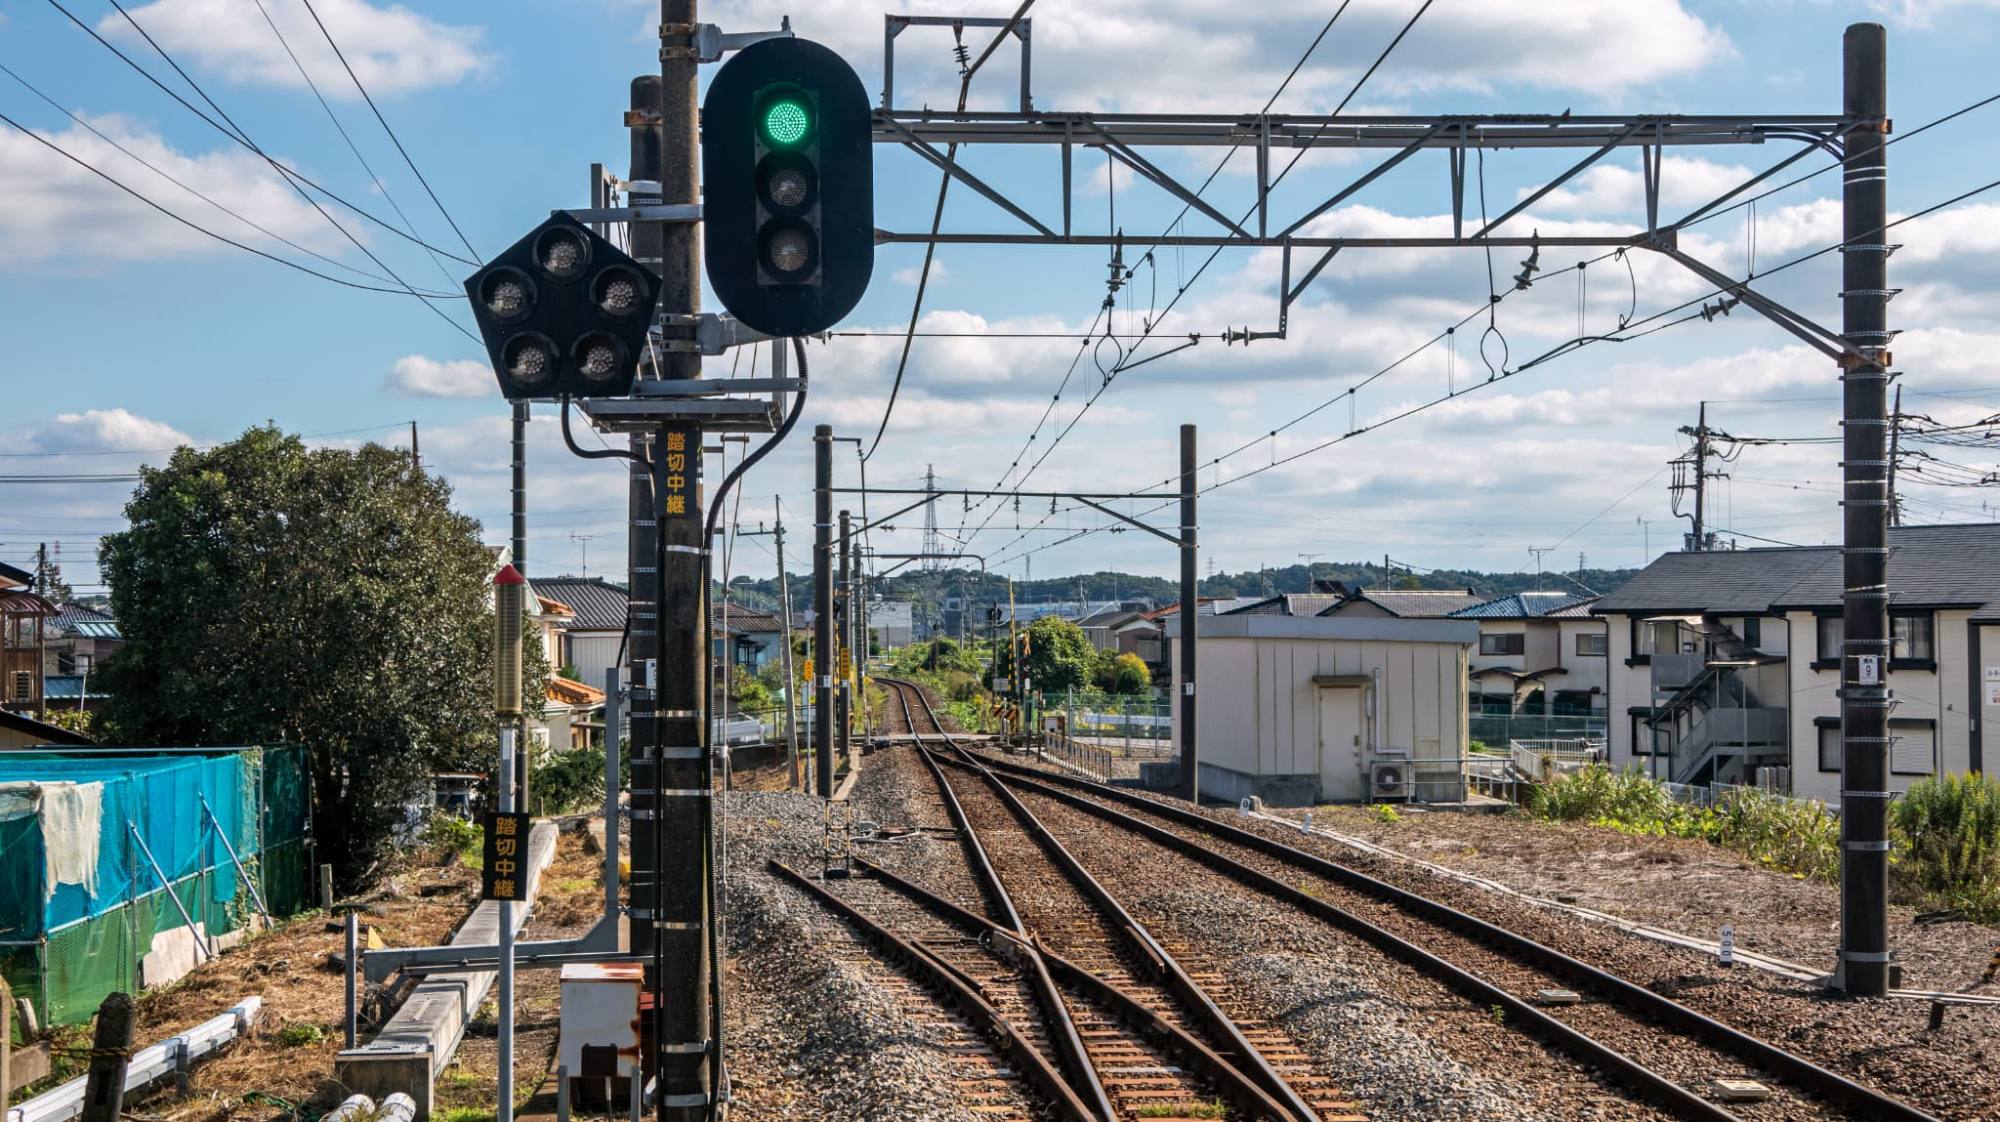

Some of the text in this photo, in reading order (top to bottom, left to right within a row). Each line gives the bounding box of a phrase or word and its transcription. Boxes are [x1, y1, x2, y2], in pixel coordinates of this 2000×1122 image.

[667, 432, 686, 514] 踏切中継
[494, 817, 517, 897] 踏切中継
[1721, 931, 1732, 956] 500
